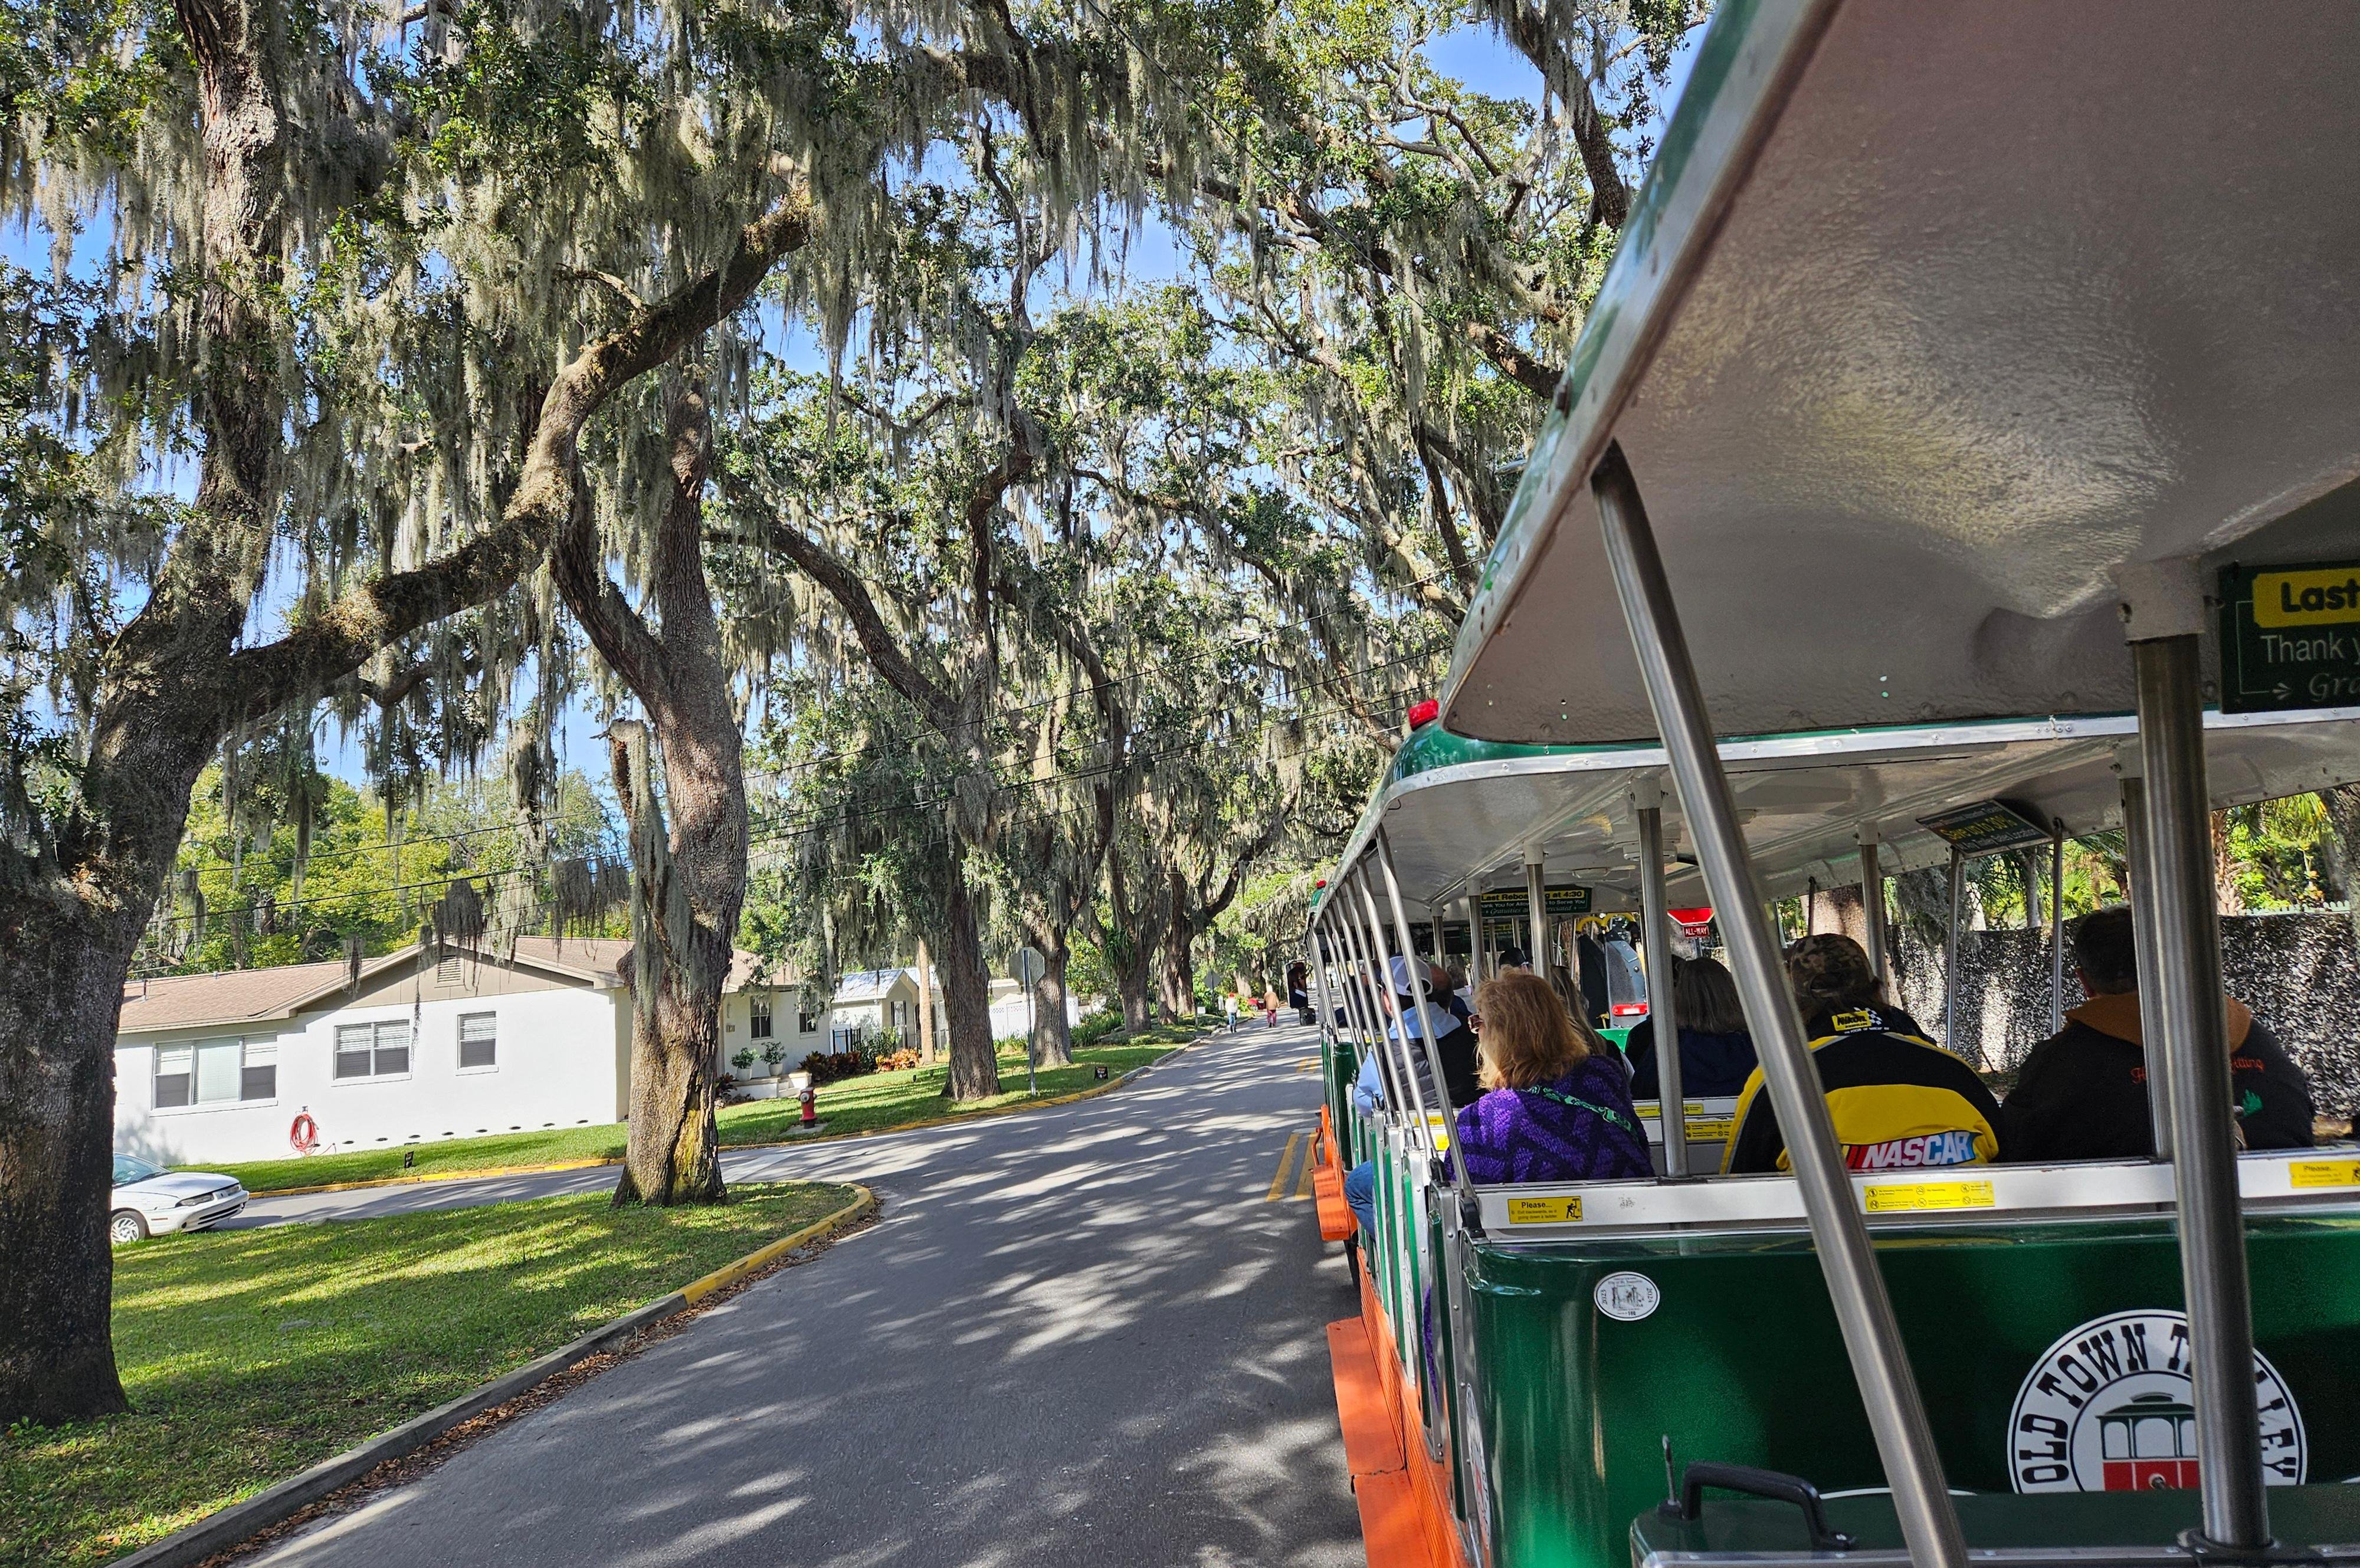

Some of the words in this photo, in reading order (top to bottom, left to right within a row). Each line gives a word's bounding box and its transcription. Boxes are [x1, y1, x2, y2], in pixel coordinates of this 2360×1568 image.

[2281, 578, 2360, 612] Last
[2260, 631, 2345, 663] Thank
[1940, 828, 1971, 841] Save
[1685, 927, 1707, 936] ALL-WAY
[1861, 1131, 1971, 1168] NASCAR
[2036, 1323, 2149, 1409] TOWN
[2018, 1413, 2069, 1484] OLD
